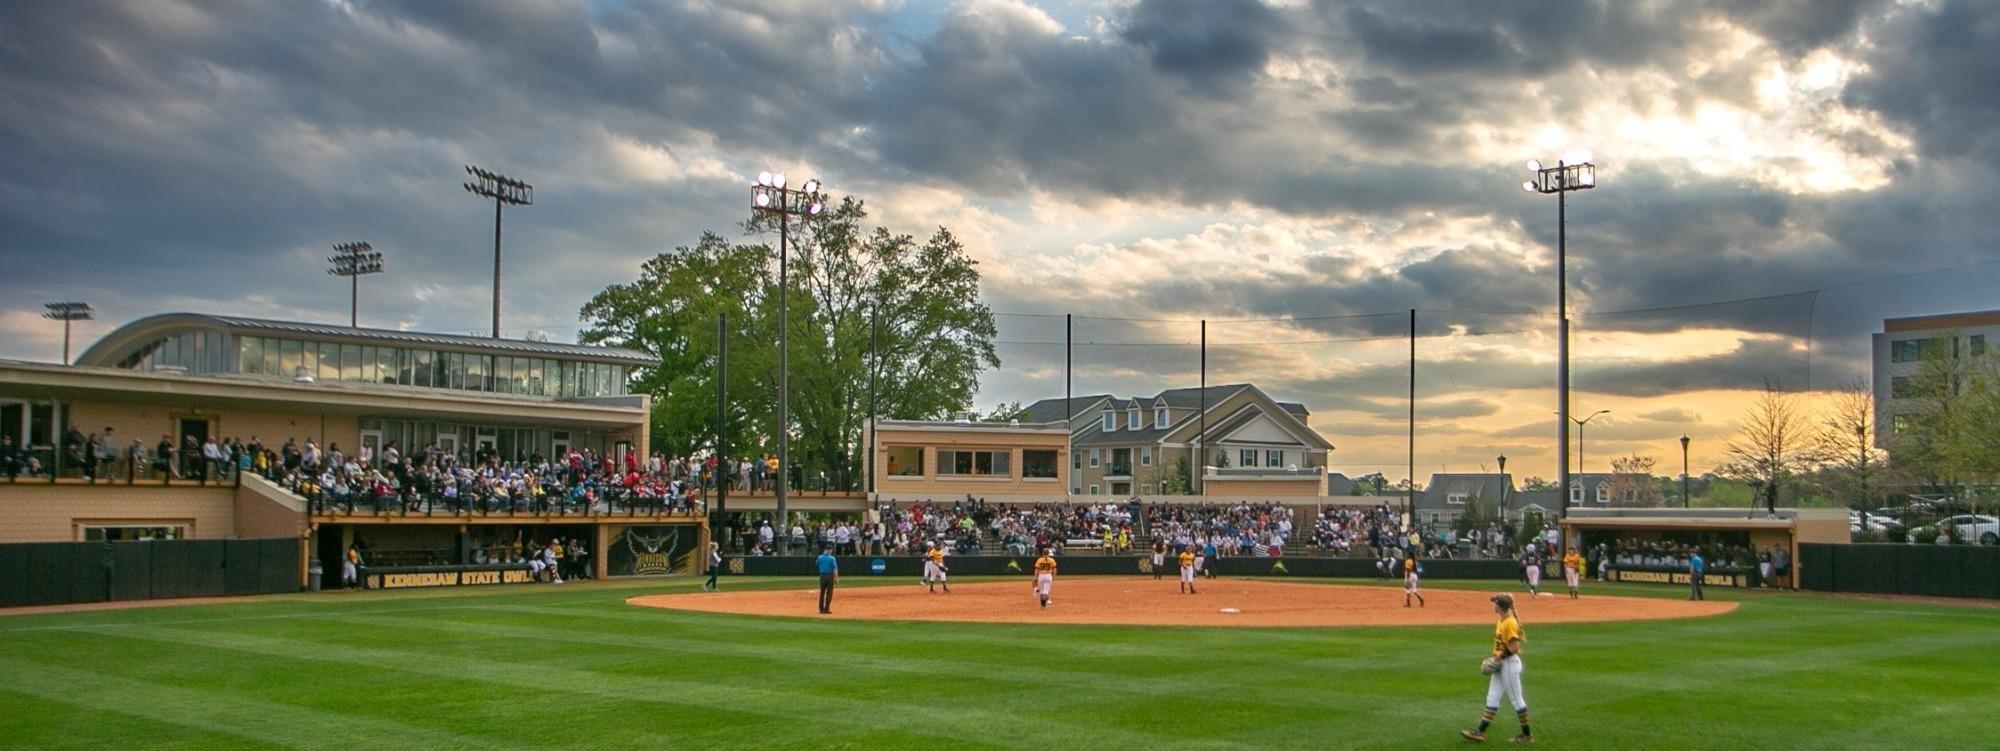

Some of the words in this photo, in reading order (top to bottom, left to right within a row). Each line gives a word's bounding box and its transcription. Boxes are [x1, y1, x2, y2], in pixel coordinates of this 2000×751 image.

[384, 572, 458, 588] KENNESAW
[461, 571, 500, 585] STATE
[503, 570, 534, 584] OWL
[1704, 574, 1733, 585] OWLS
